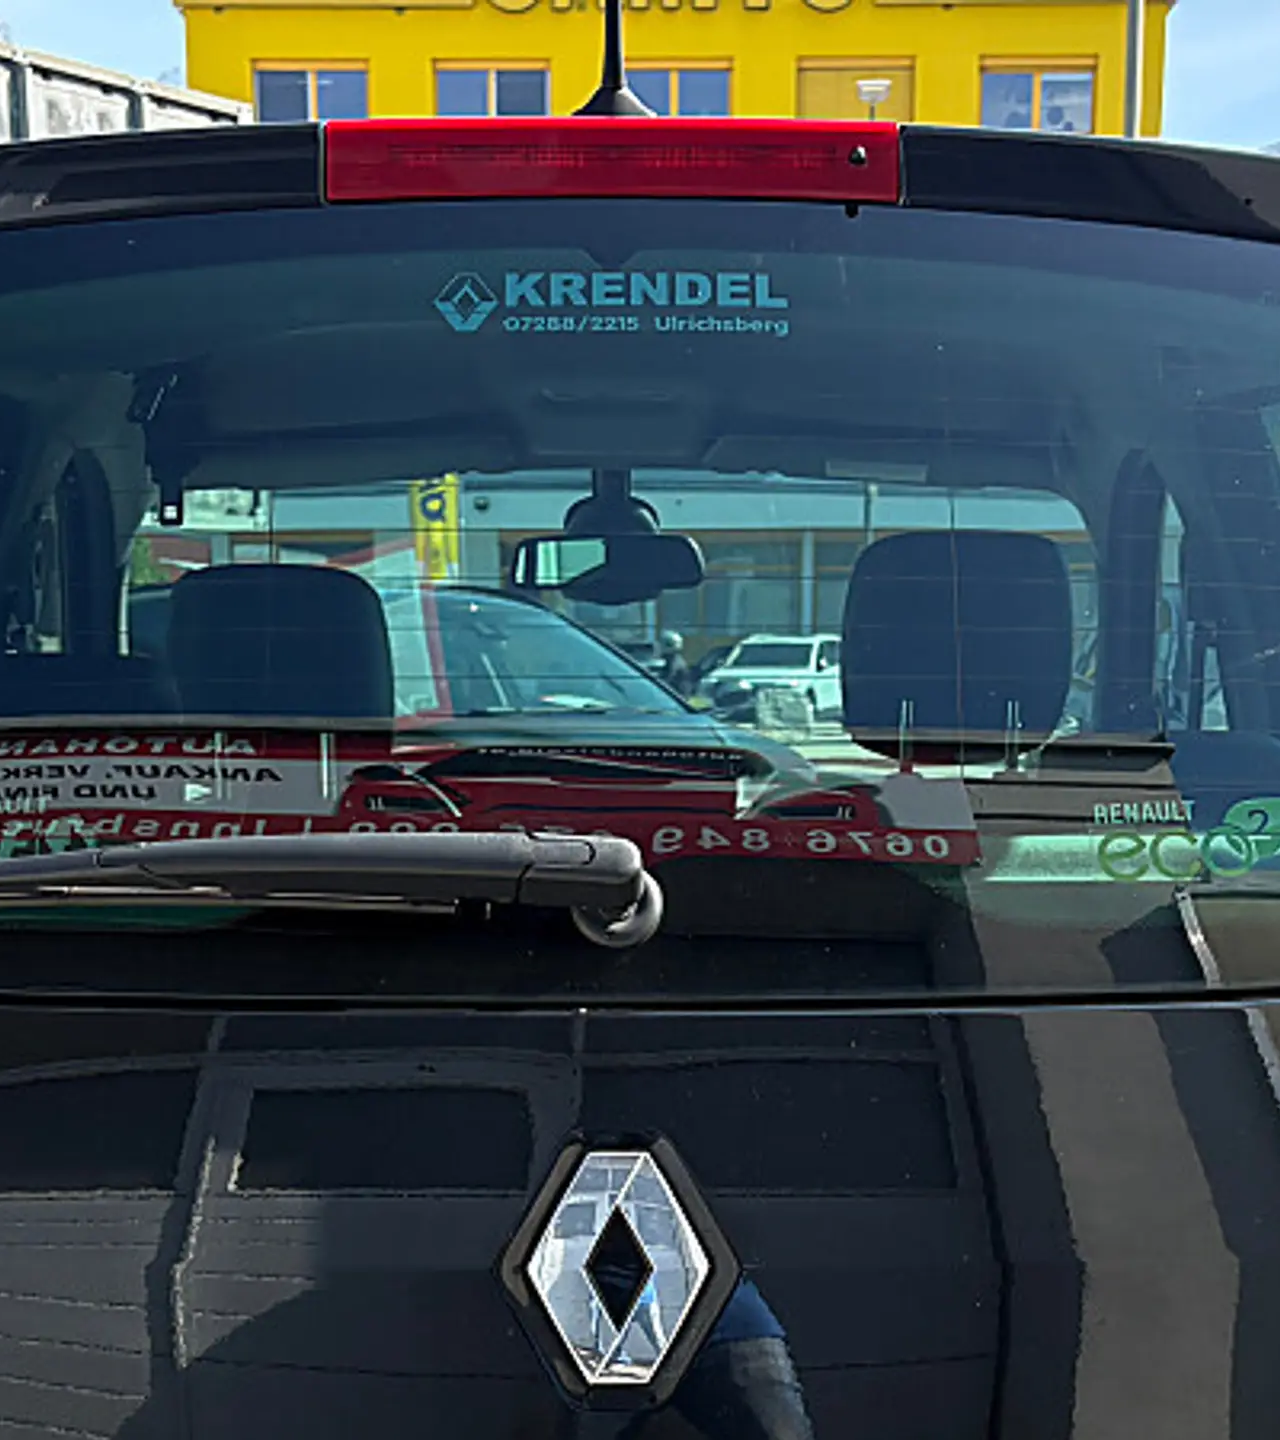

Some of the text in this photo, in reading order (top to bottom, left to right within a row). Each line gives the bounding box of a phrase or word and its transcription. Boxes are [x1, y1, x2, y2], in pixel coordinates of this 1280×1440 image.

[505, 272, 789, 308] KRENDEL
[655, 317, 790, 336] Ulrichsberg
[1094, 800, 1196, 825] RENAULT
